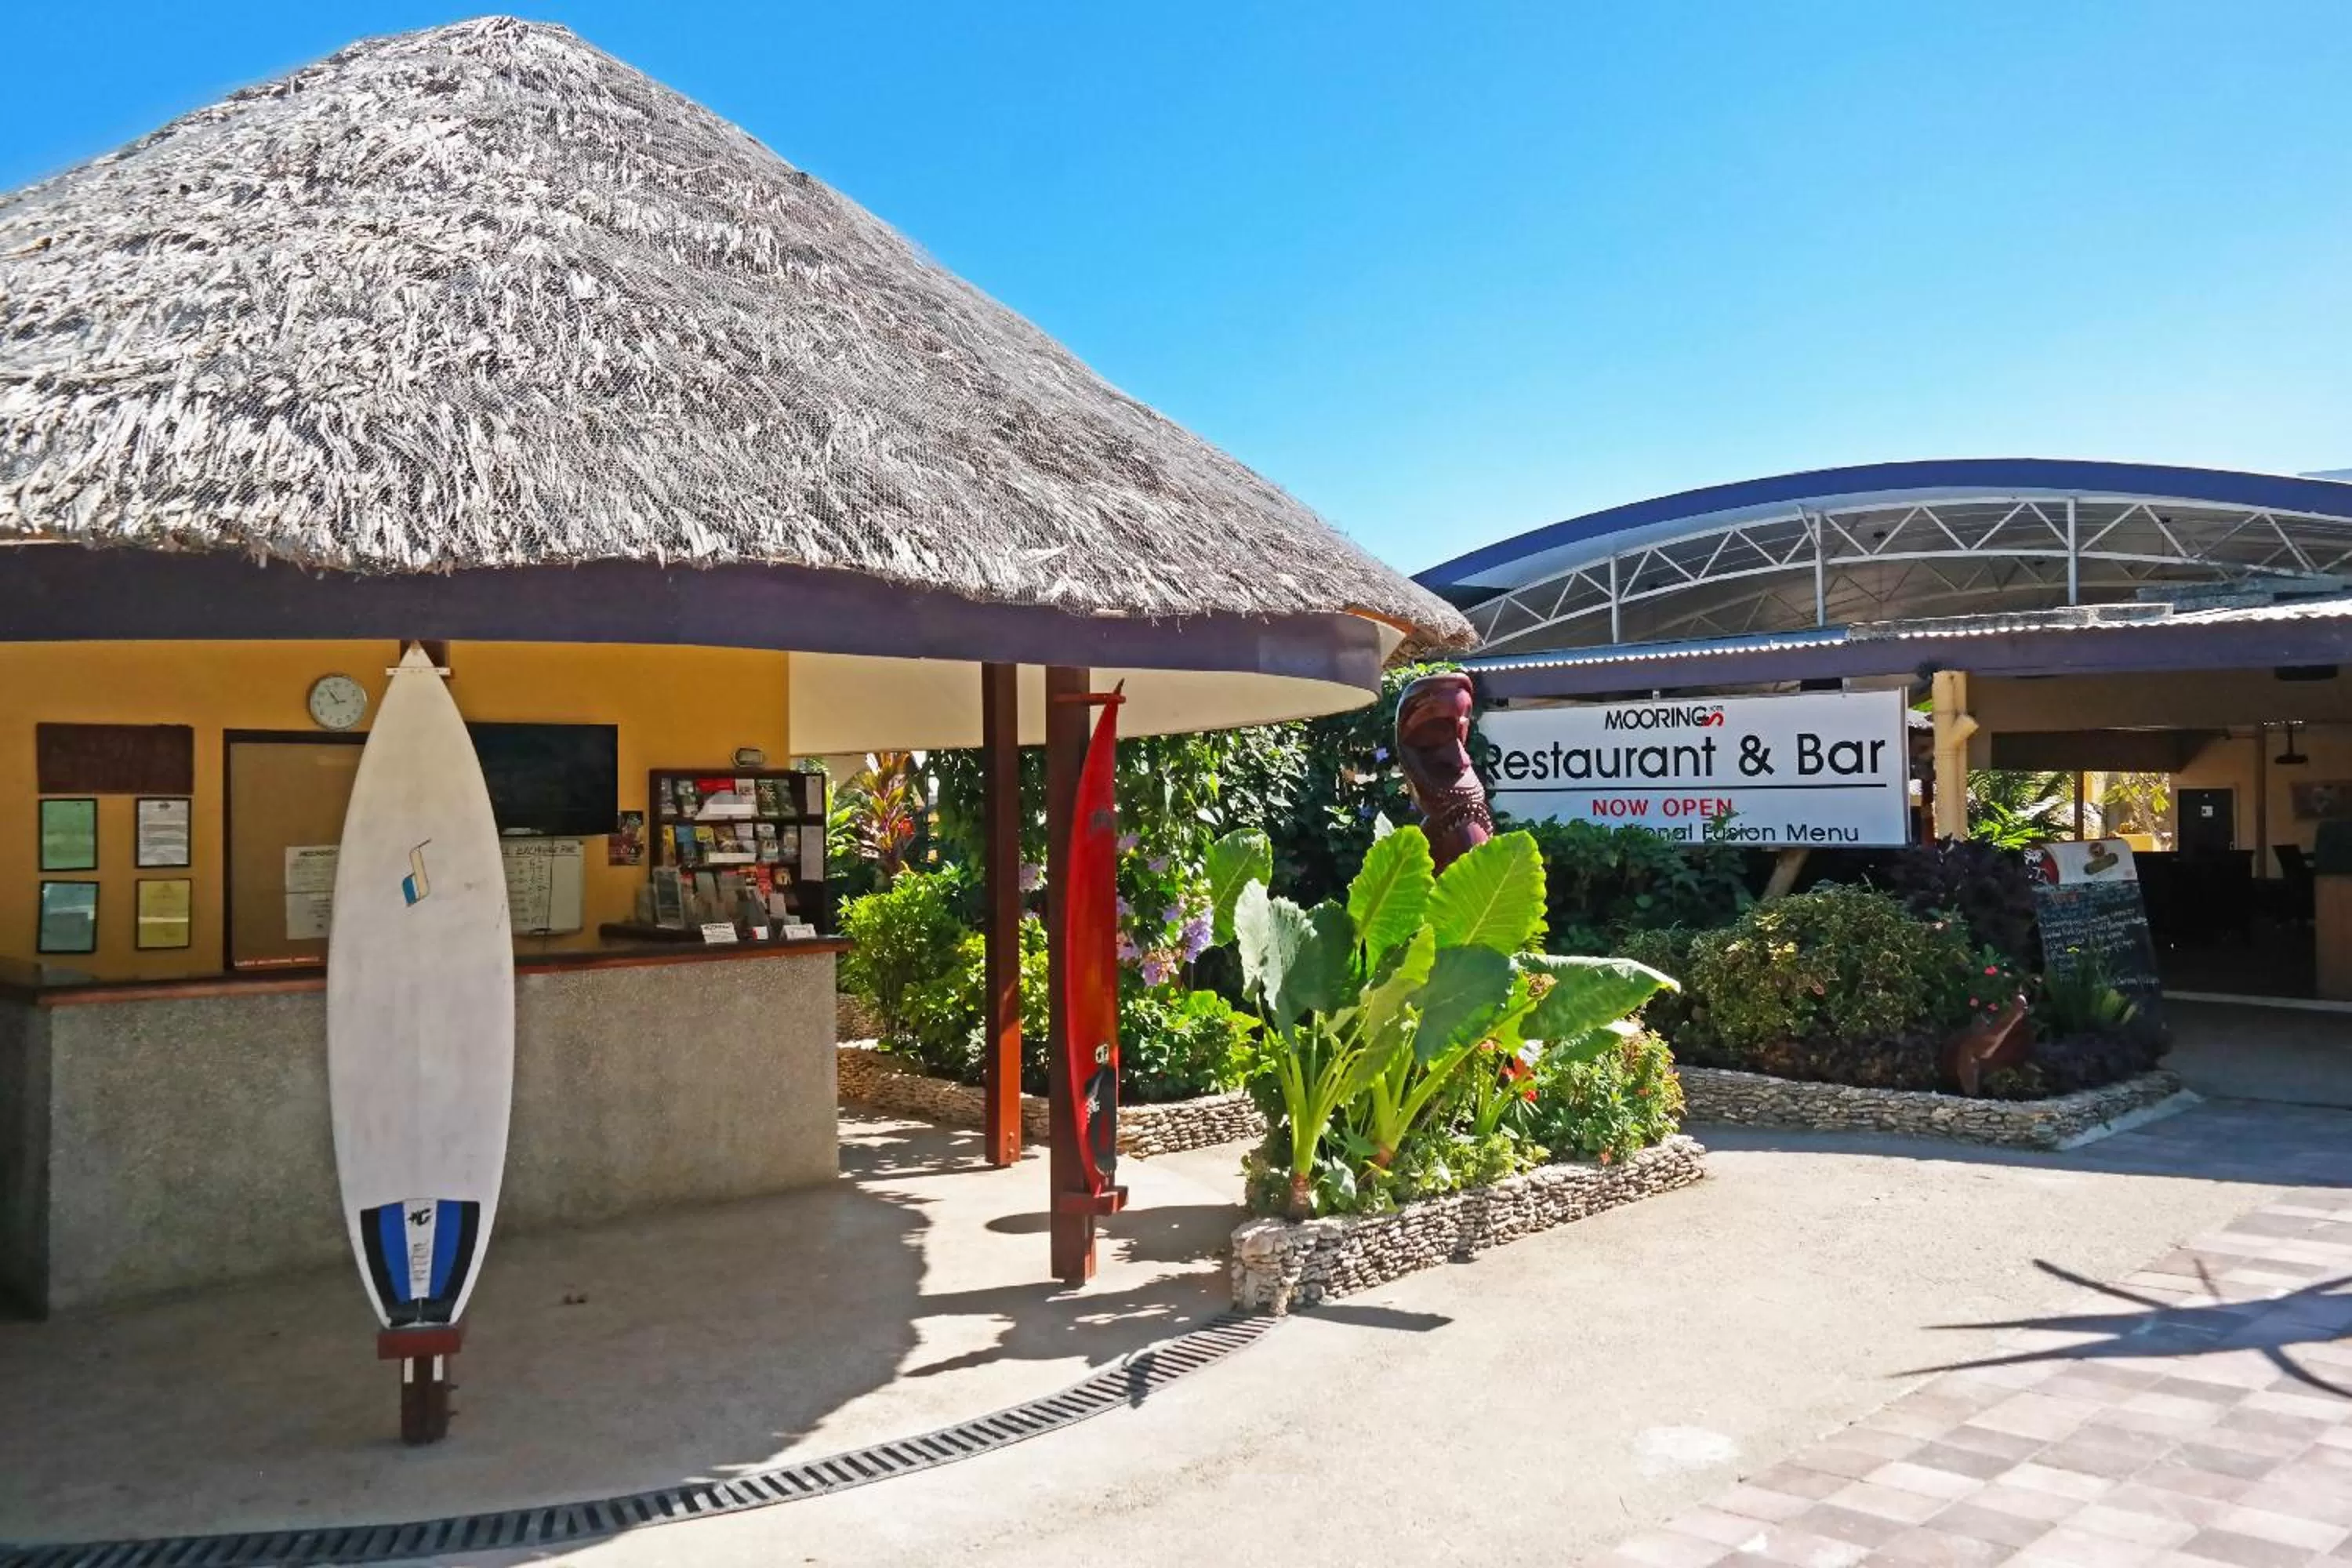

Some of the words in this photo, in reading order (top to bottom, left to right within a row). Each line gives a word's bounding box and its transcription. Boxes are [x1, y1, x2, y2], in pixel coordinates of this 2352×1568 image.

[1604, 706, 1724, 730] MOORINGS
[1486, 736, 1717, 780] Restaurant
[1738, 734, 1776, 776] &
[1797, 733, 1886, 775] Bar
[1592, 798, 1649, 817] NOW
[1662, 797, 1733, 817] OPEN
[1702, 822, 1777, 842] Fusion
[1786, 823, 1860, 842] Menu
